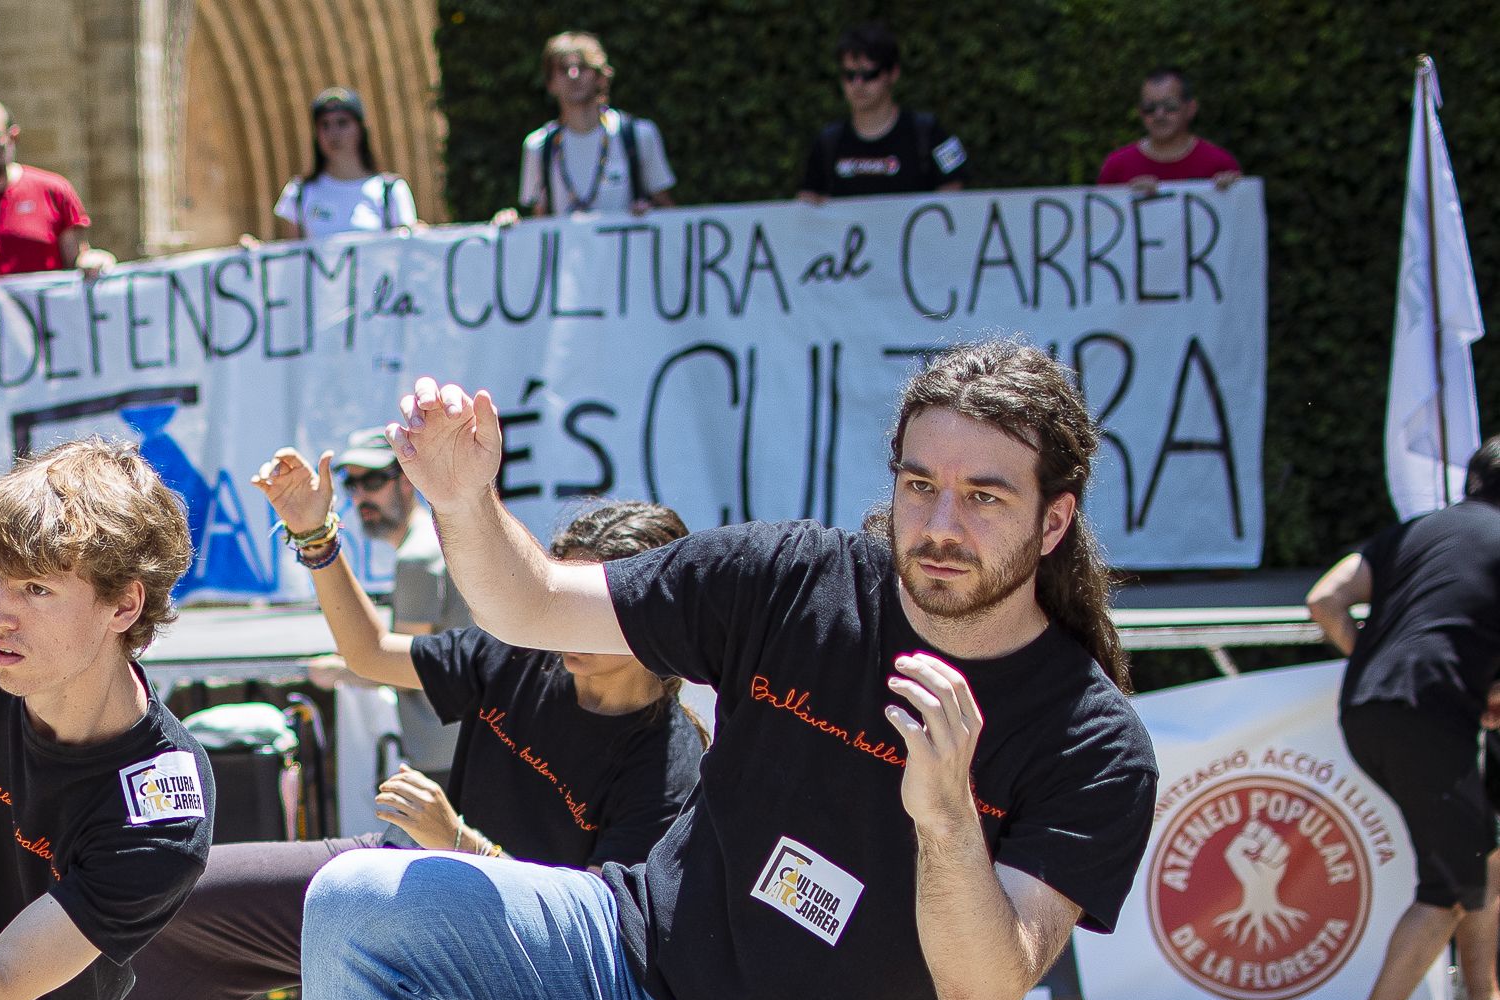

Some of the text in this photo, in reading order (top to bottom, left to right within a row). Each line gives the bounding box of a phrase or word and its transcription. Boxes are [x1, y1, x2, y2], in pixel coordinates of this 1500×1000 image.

[364, 272, 423, 317] la
[445, 217, 791, 329] CULTURA
[799, 223, 873, 287] al
[900, 190, 1223, 321] CARRER
[500, 333, 1244, 540] ÉS CULRA
[1263, 749, 1334, 784] ACCIÓ
[1161, 790, 1357, 893] ATENEU POPULAR
[1169, 919, 1350, 988] DE LA FLORESTA
